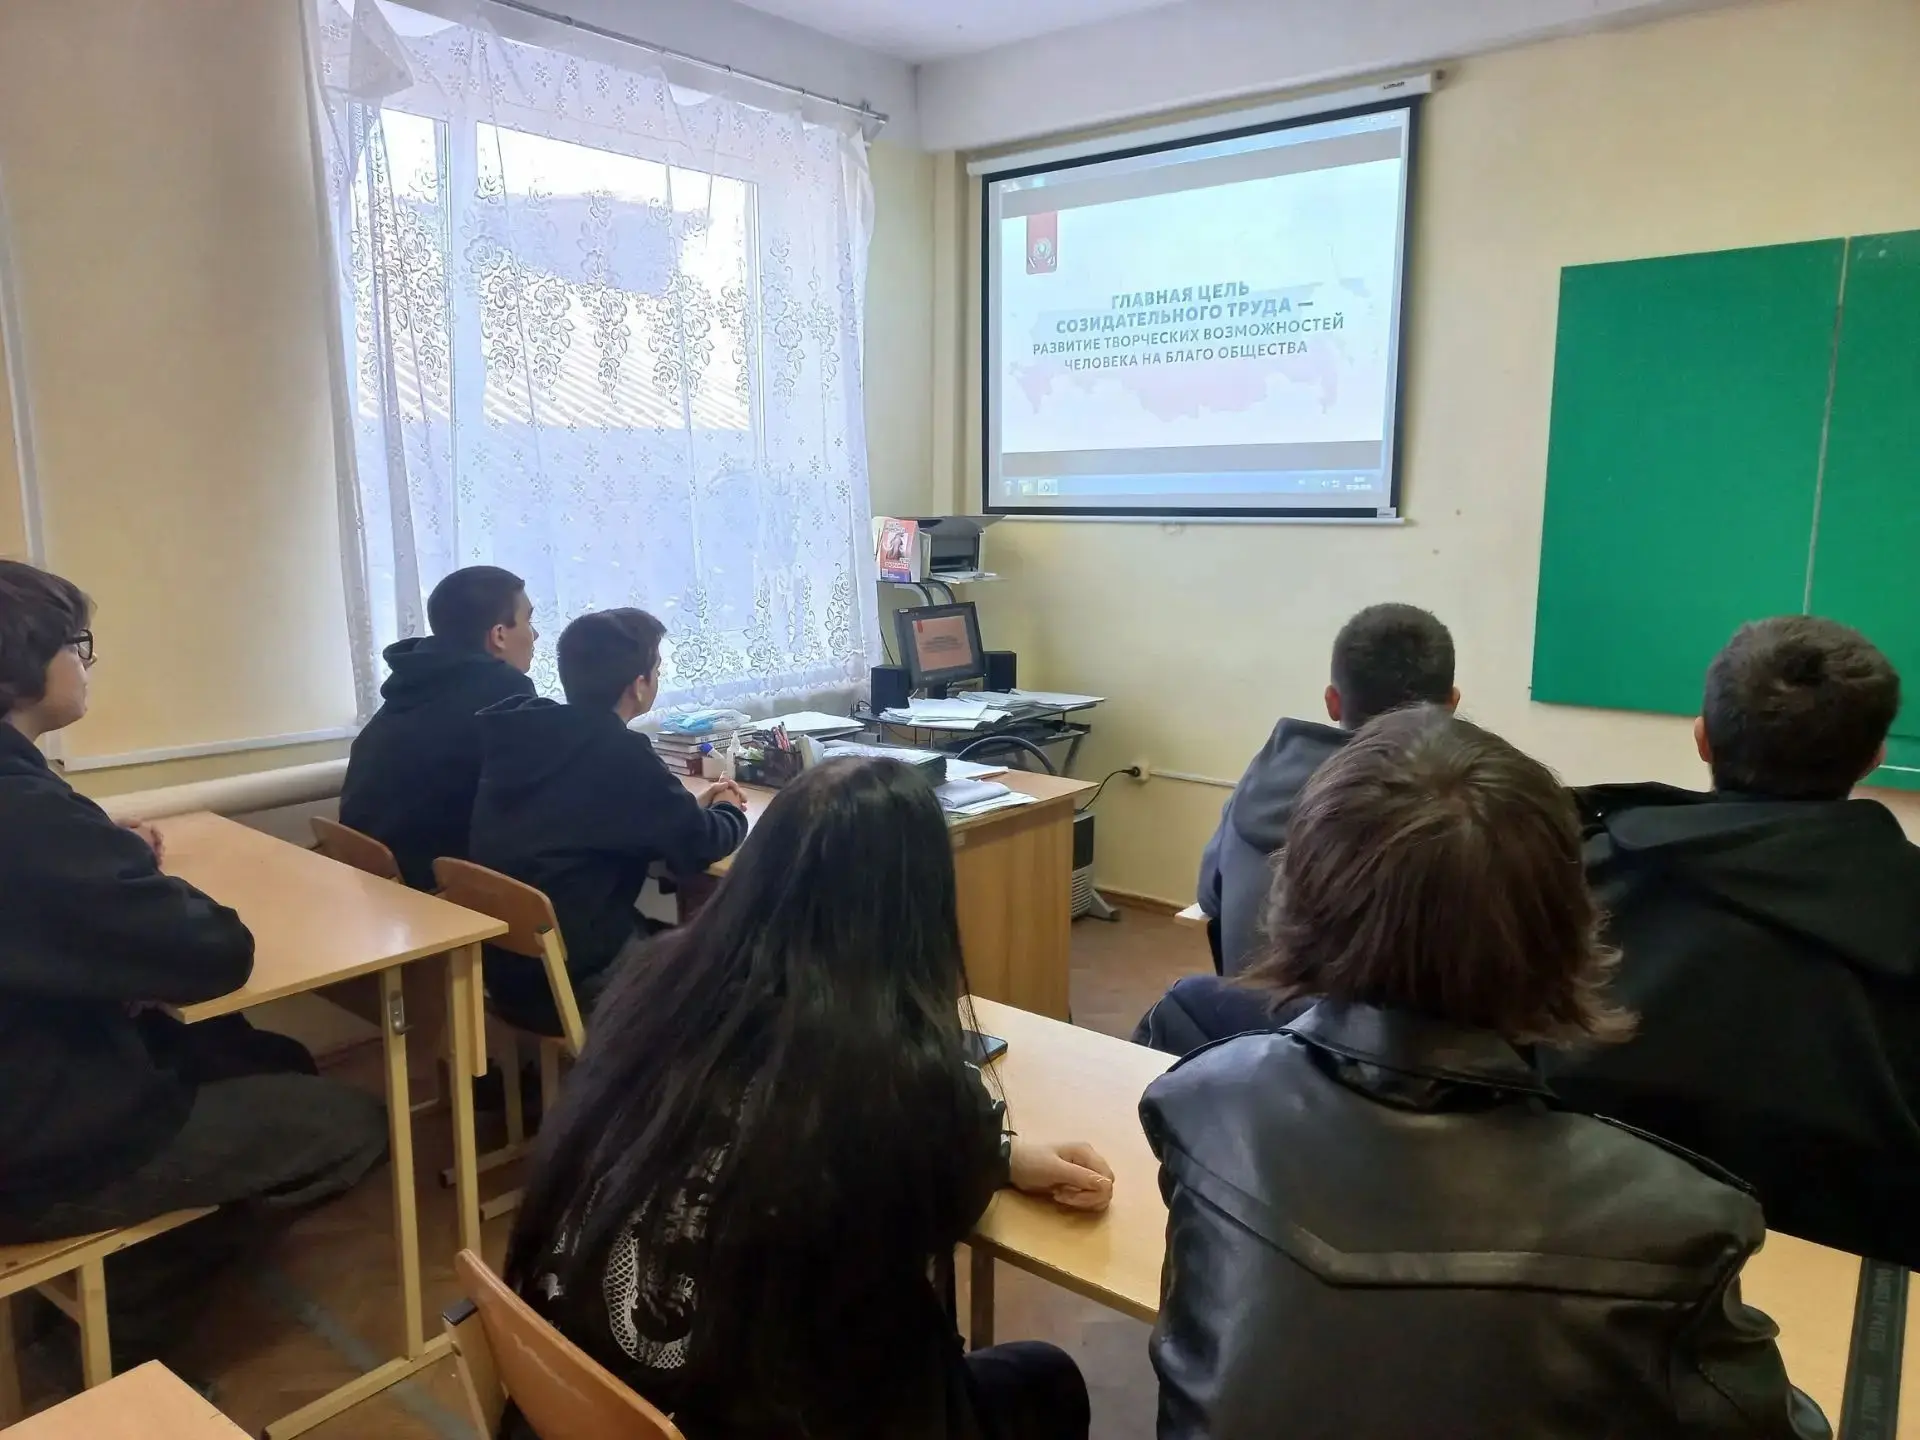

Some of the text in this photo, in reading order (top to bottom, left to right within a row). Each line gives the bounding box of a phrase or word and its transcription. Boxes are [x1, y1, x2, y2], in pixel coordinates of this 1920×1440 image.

[1111, 281, 1250, 309] ГЛАВНАЯ ЦЕЛЬ
[1056, 304, 1222, 333] СОЗИДАТЕЛЬНОГО
[1227, 297, 1291, 317] ТРУДА
[1033, 312, 1344, 355] РАЗВИТИЕ ТВОРЧЕСКИХ ВОЗМОЖНОСТЕЙ
[1064, 341, 1308, 371] ЧЕЛОВЕКА НА БЛАГО ОБЩЕСТВА
